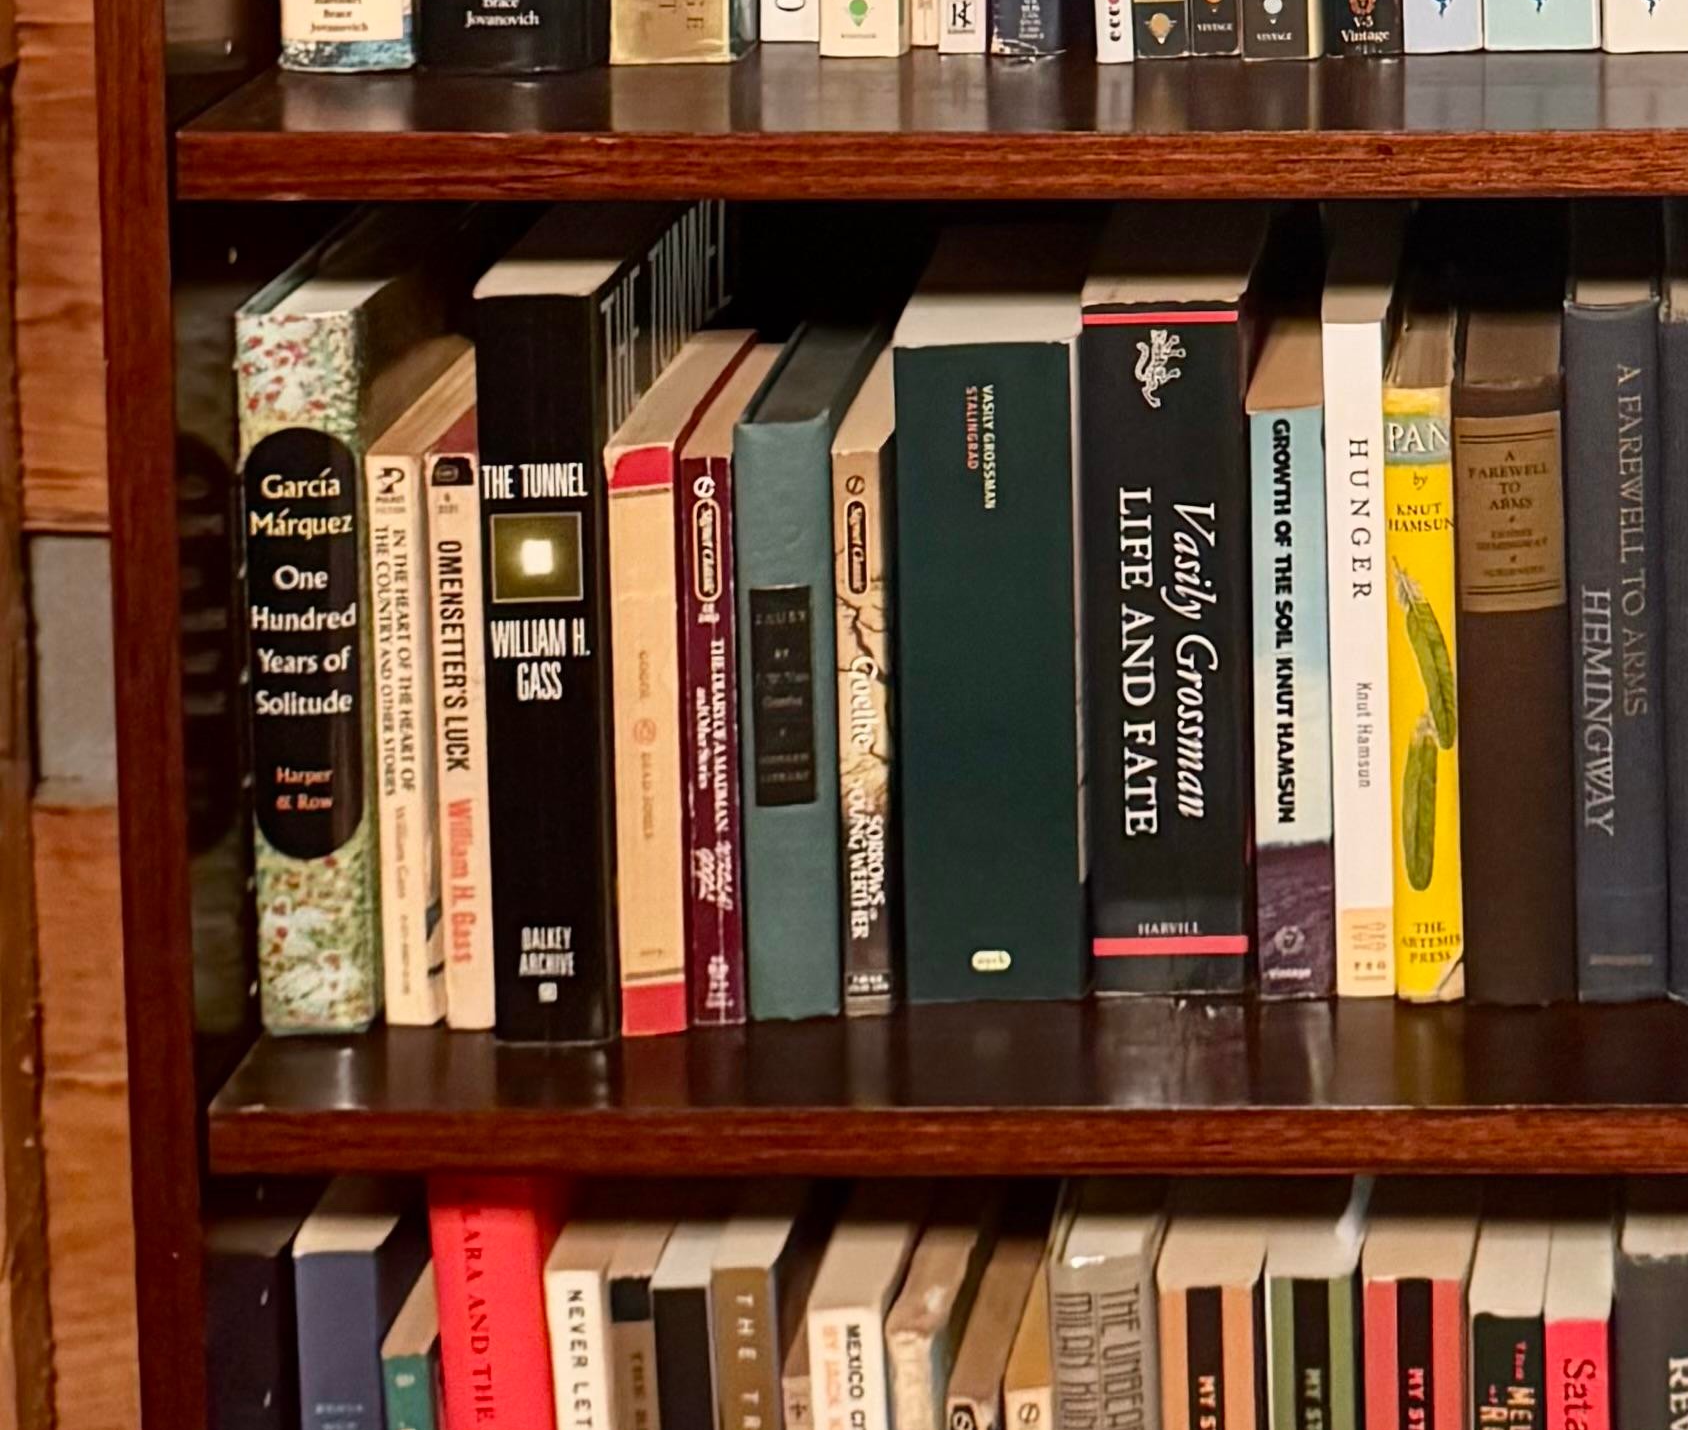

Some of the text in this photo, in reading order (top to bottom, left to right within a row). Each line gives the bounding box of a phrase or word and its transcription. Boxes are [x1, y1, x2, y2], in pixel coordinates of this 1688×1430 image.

[262, 474, 340, 501] García
[482, 463, 587, 499] THE TUNNEL
[250, 509, 353, 539] Márquez
[1349, 438, 1372, 600] HUNGER
[274, 564, 327, 591] One
[250, 604, 356, 631] Hundred
[491, 619, 590, 659] WILLIAM H.
[1161, 499, 1219, 819] Vasily Grossman
[257, 646, 351, 675] Years of
[1119, 487, 1159, 836] LIFE AND FATE
[517, 661, 562, 701] GASS
[256, 688, 353, 716] Solitude
[1581, 586, 1614, 838] HEMINGWAY
[566, 1289, 588, 1371] NEVER
[737, 1294, 757, 1360] THE
[573, 1383, 591, 1428] LET
